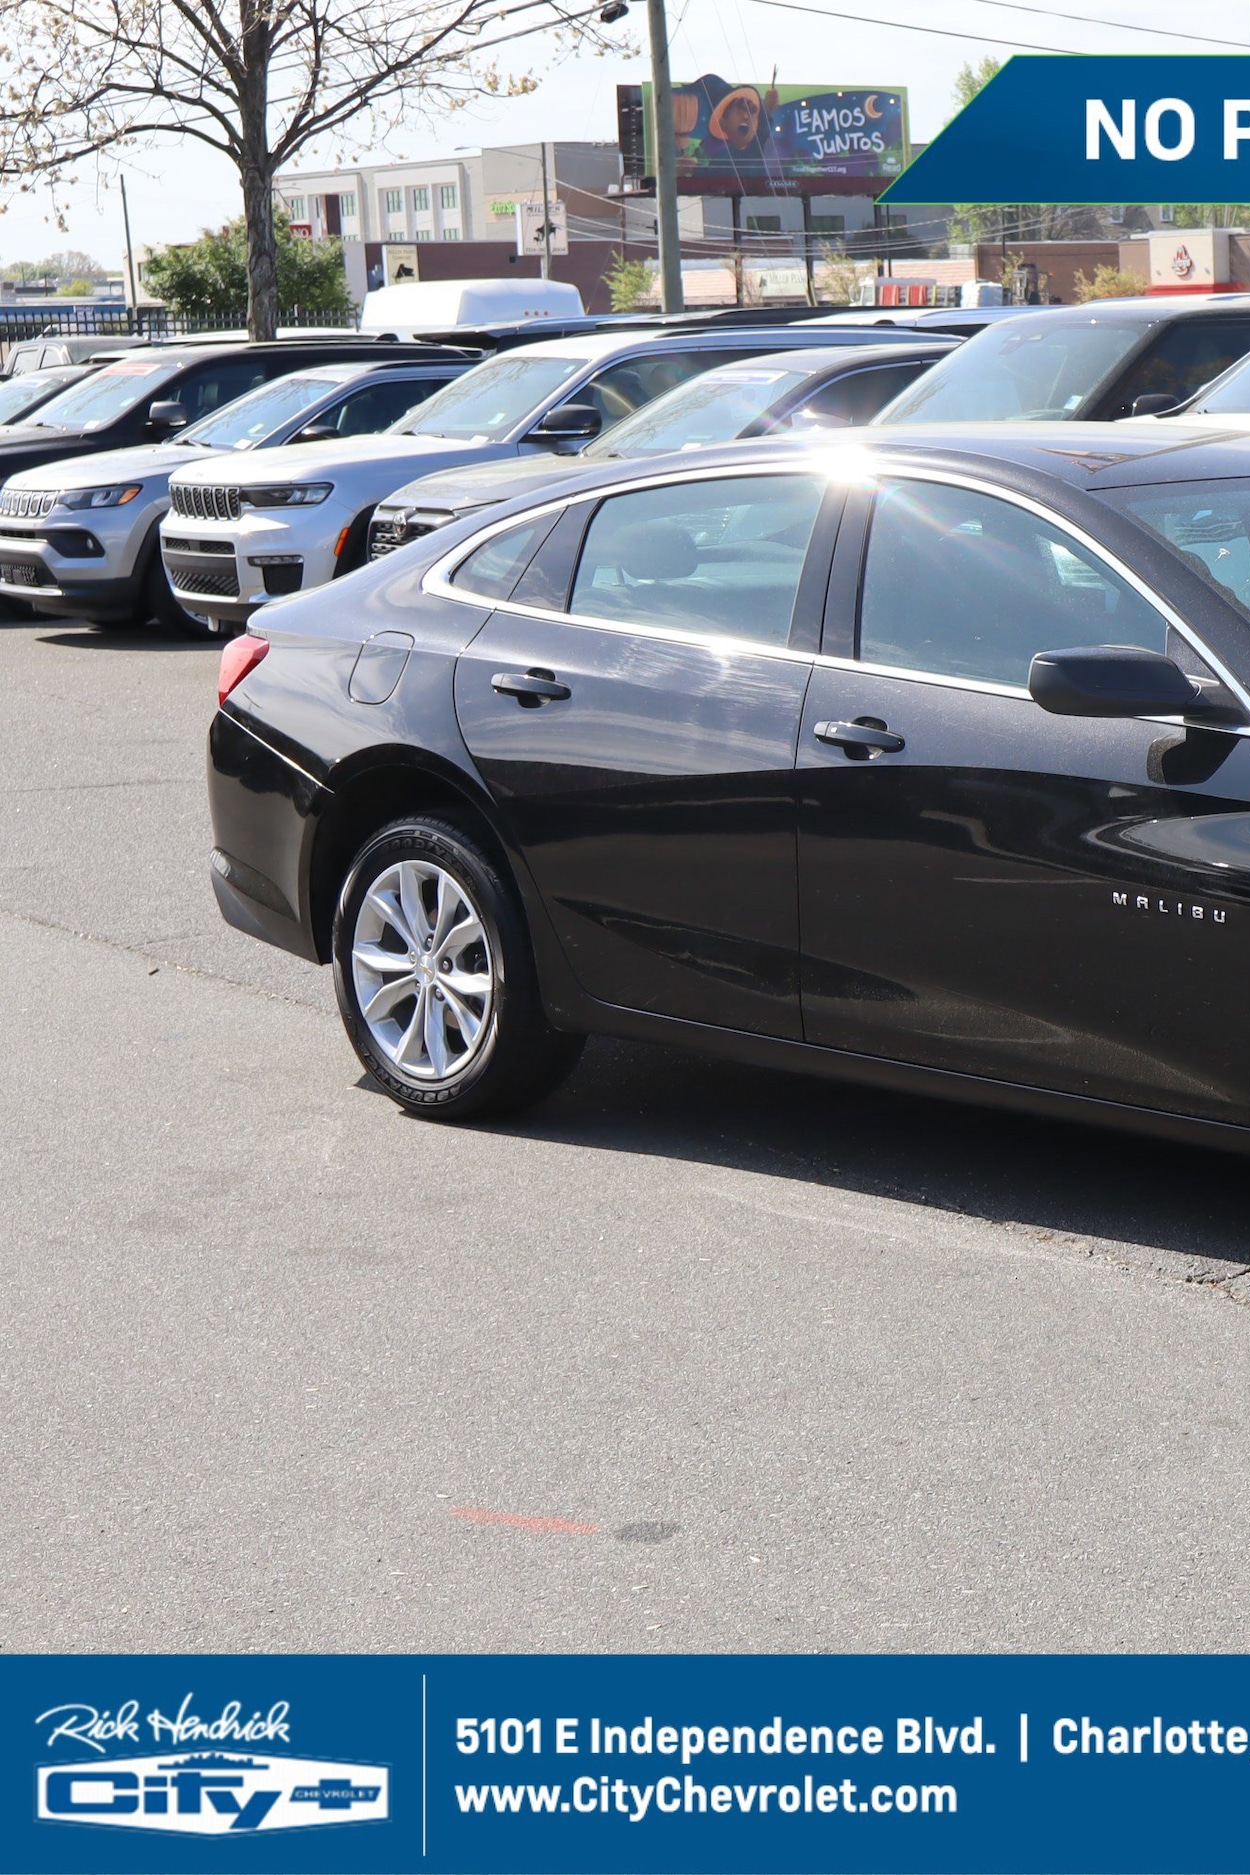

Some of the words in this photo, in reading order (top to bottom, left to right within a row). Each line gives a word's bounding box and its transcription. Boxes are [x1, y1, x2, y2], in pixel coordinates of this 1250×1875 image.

[794, 107, 866, 133] LEAMOS
[807, 131, 885, 160] JUNTOS
[1112, 891, 1226, 923] MALIBU
